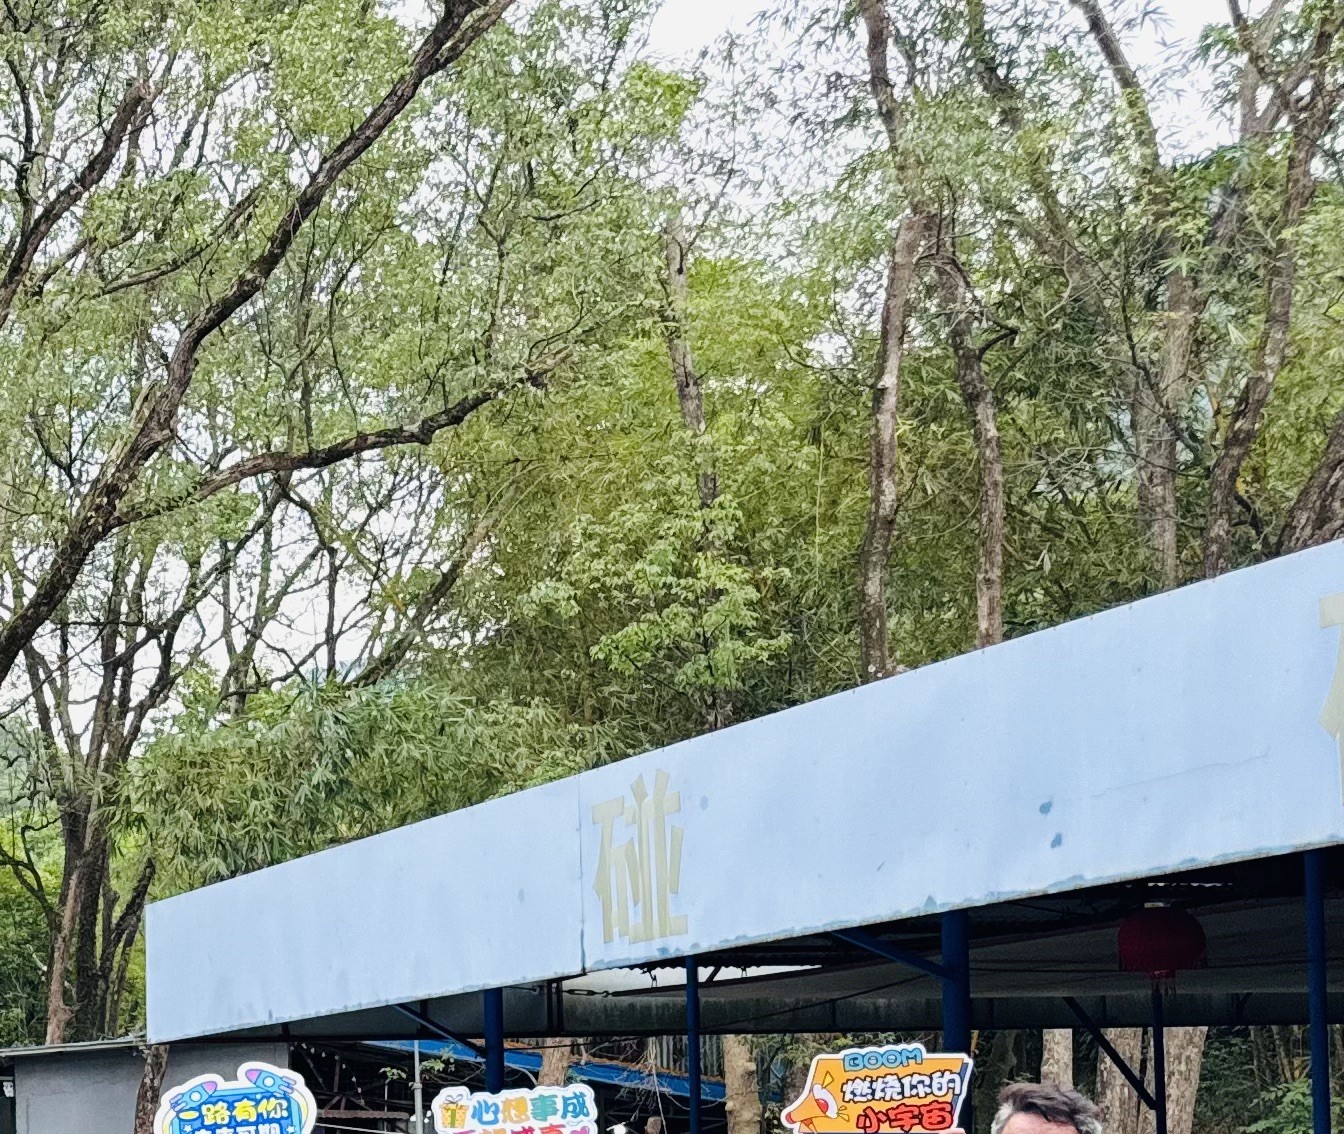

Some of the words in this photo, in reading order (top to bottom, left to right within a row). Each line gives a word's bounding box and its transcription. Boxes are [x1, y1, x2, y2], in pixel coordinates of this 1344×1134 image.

[843, 1048, 922, 1072] BOOM
[842, 1069, 961, 1102] 燃烧你的
[178, 1098, 289, 1125] 一路有你
[471, 1091, 590, 1125] 心想事成
[856, 1100, 954, 1134] 小宇宙
